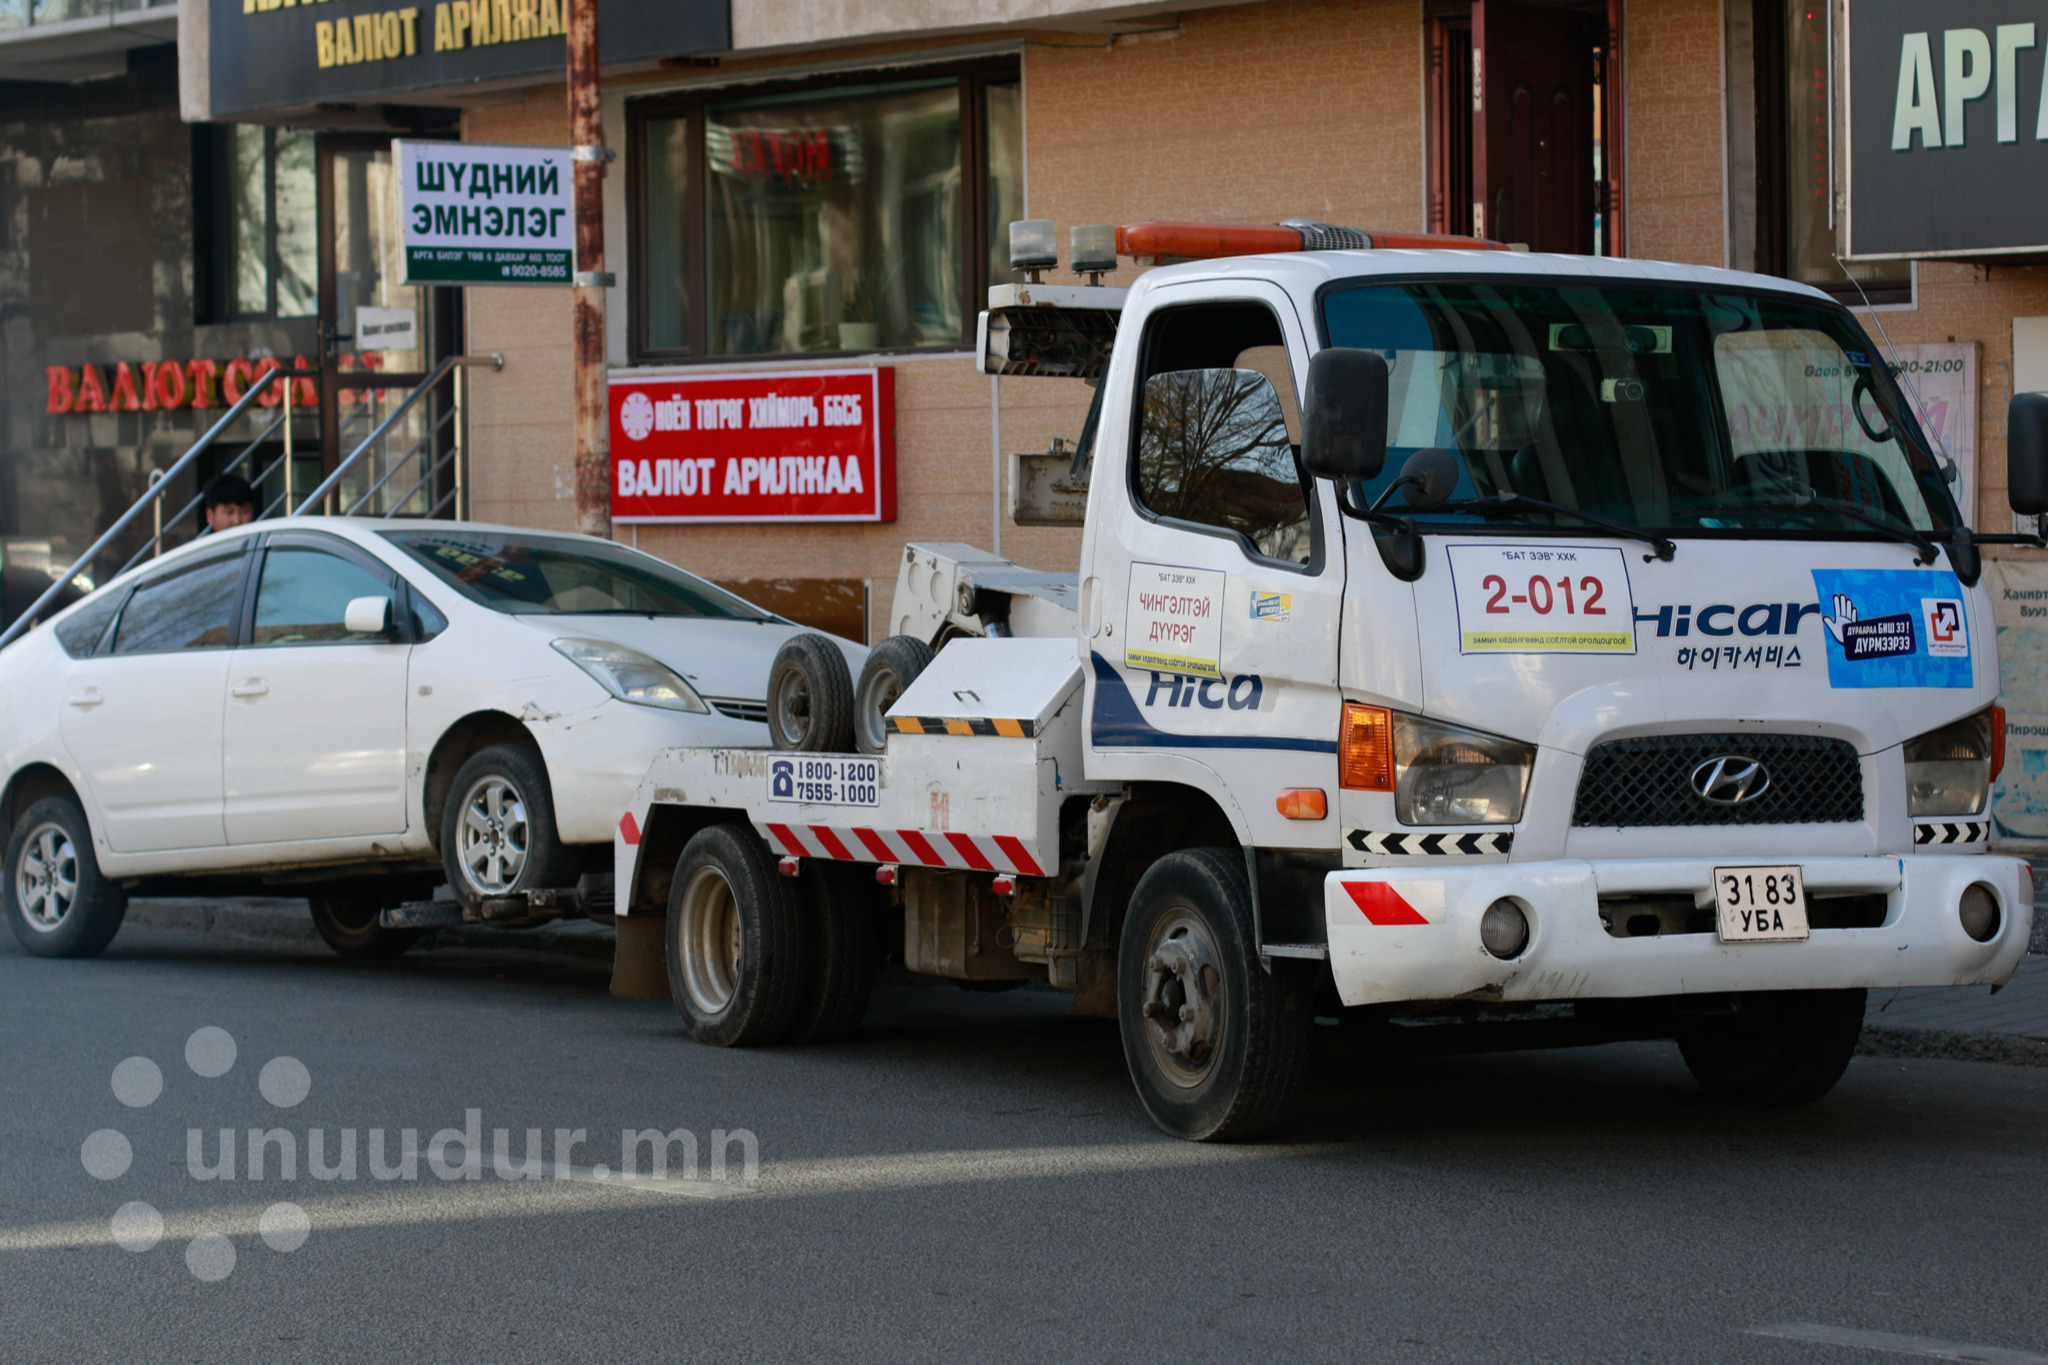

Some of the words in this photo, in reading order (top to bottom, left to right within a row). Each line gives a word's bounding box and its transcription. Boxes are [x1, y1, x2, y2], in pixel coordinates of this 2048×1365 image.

[315, 7, 418, 69] ВАЛЮТ
[416, 158, 559, 200] ШҮДНИЙ
[412, 204, 566, 237] ЭМНЭЛЭГ
[413, 250, 434, 260] АРГА
[495, 252, 526, 263] ДАВХАР
[512, 265, 566, 277] 9020-8585
[655, 393, 690, 431] НОЁН
[823, 394, 862, 426] ББСБ
[617, 458, 716, 497] ВАЛЮТ
[722, 455, 864, 496] АРИЛЖАА
[1556, 552, 1577, 562] ХХК
[1139, 592, 1211, 619] ЧИНГЭЛТЭЙ
[1482, 574, 1607, 616] 2-012
[1149, 621, 1197, 643] ДҮҮРЭГ
[1633, 603, 1822, 638] Hicar
[1877, 622, 1895, 635] БИШ
[1854, 635, 1910, 654] ДҮРМЭЭРЭЭ
[1677, 645, 1802, 670] 하이카서비스
[798, 762, 876, 782] 1800-1200
[797, 783, 876, 803] 7555-1000
[1740, 909, 1784, 932] УБА
